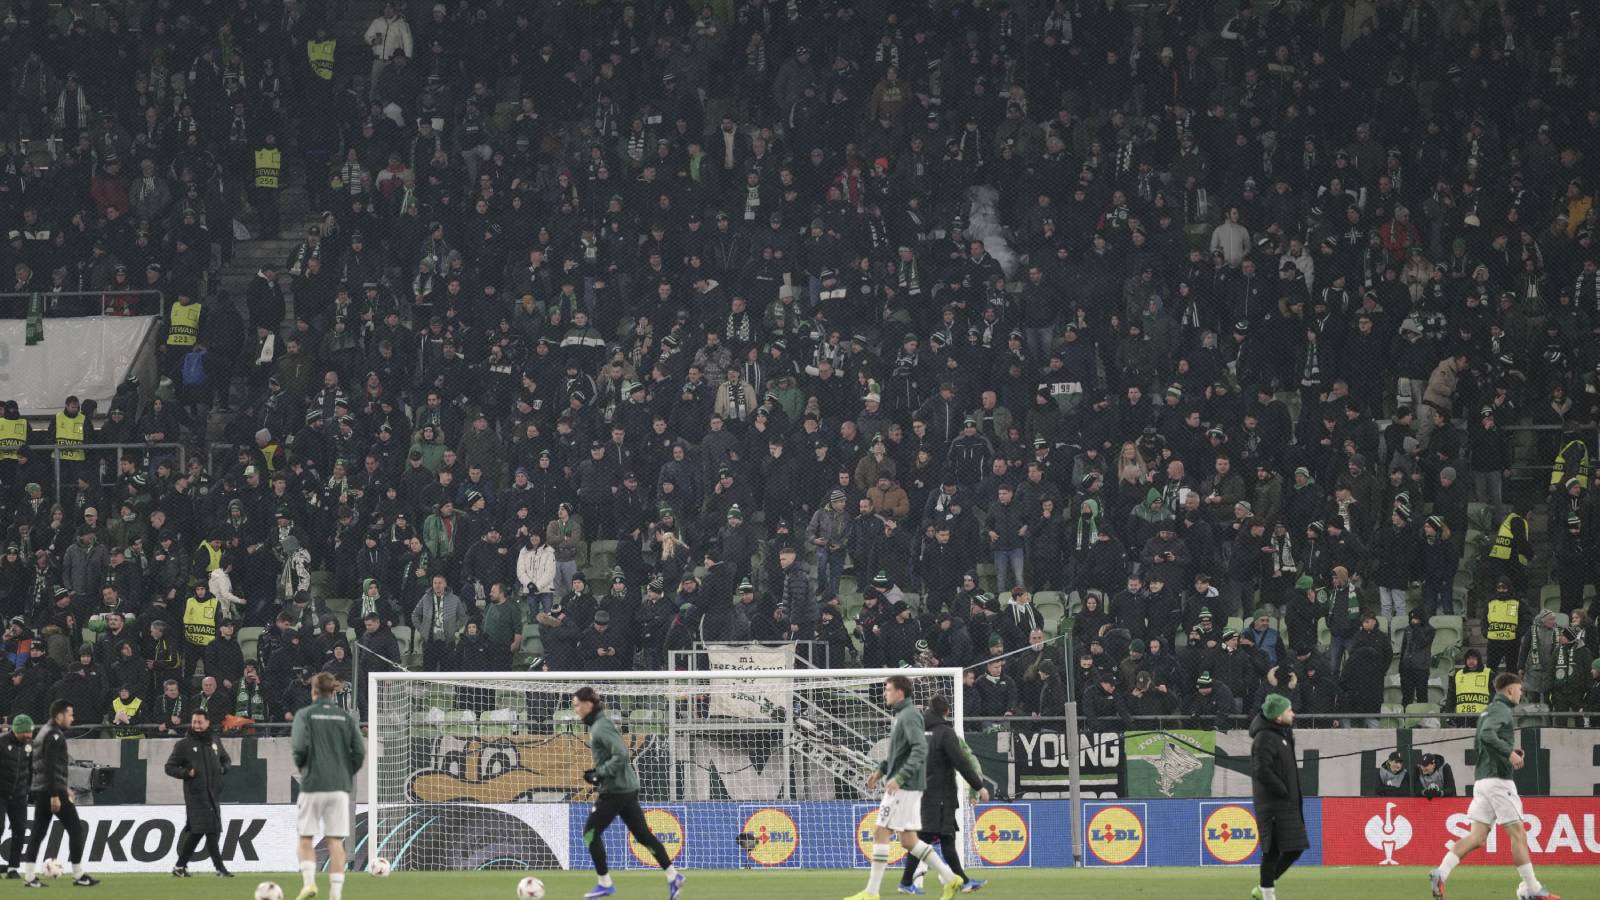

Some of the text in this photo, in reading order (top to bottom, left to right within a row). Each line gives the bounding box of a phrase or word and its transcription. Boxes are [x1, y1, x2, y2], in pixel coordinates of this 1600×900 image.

[1461, 704, 1477, 713] 285
[1018, 731, 1120, 768] YOUNG
[1137, 732, 1202, 752] TORADOS
